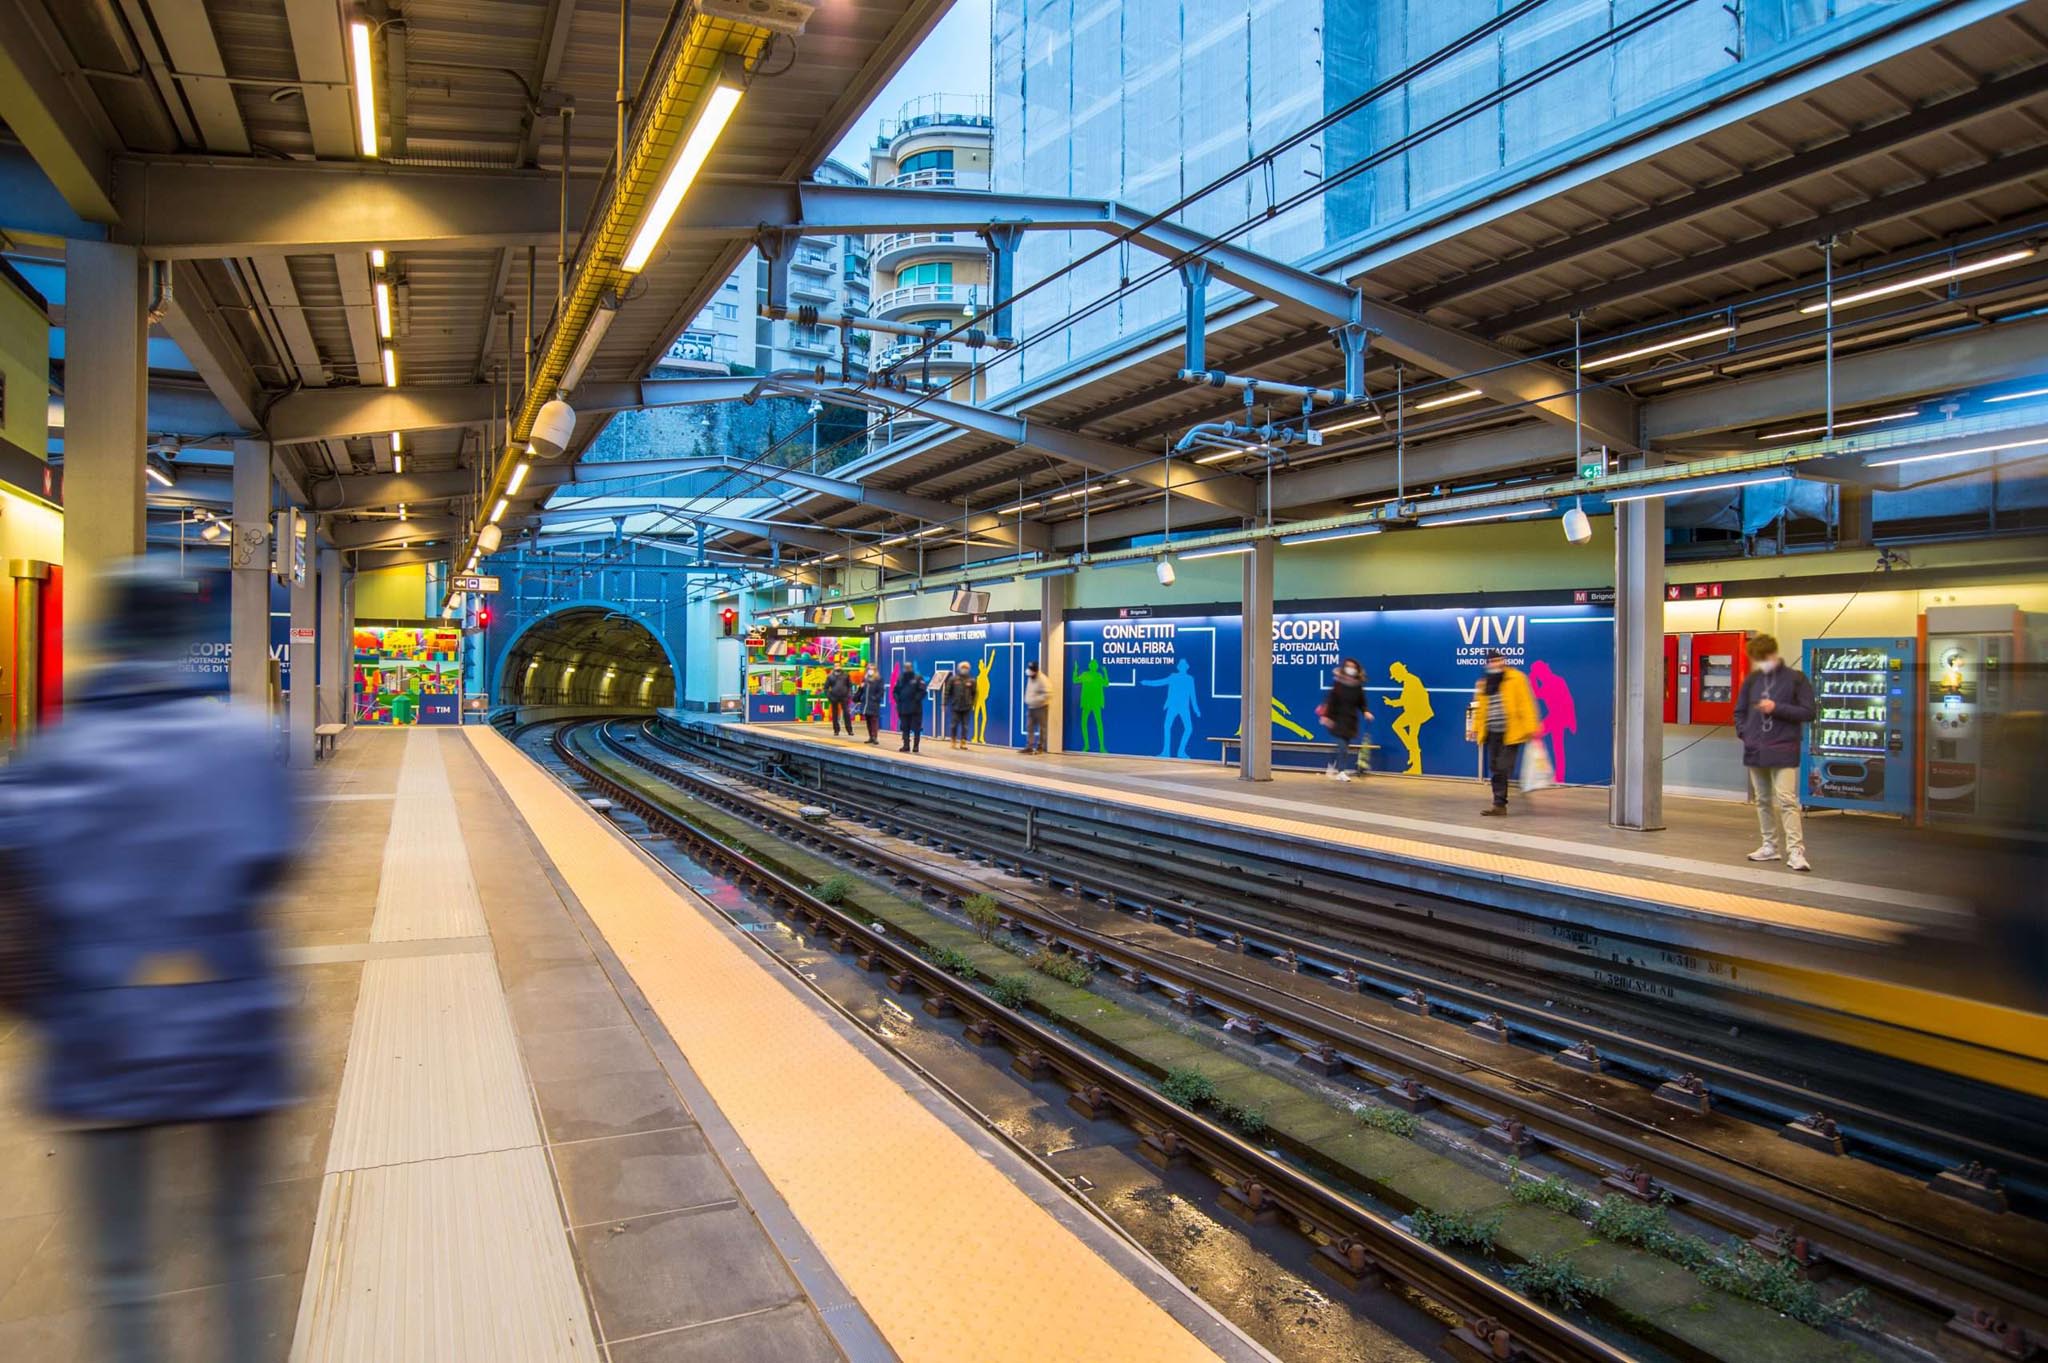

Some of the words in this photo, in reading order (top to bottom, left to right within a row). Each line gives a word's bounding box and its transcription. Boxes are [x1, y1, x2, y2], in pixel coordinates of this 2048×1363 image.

[1576, 592, 1585, 601] M
[1591, 592, 1616, 601] Brignol
[1102, 624, 1175, 639] CONNETTITI
[1456, 615, 1525, 645] VIVI
[1102, 642, 1125, 654] CON
[1126, 642, 1141, 654] LA
[1142, 641, 1175, 654] FIBRA
[1280, 640, 1340, 651] POTENZIALITÀ
[1456, 648, 1468, 656] LO
[1102, 657, 1107, 665] E
[1107, 657, 1116, 665] LA
[1115, 657, 1131, 665] RETE
[1131, 657, 1155, 665] MOBILE
[1155, 657, 1162, 665] DI
[1163, 657, 1175, 665] TIM
[1290, 654, 1304, 664] 5G
[1306, 654, 1318, 664] DI
[1319, 654, 1339, 664] TIM
[212, 665, 223, 673] DI
[768, 705, 785, 713] TIM
